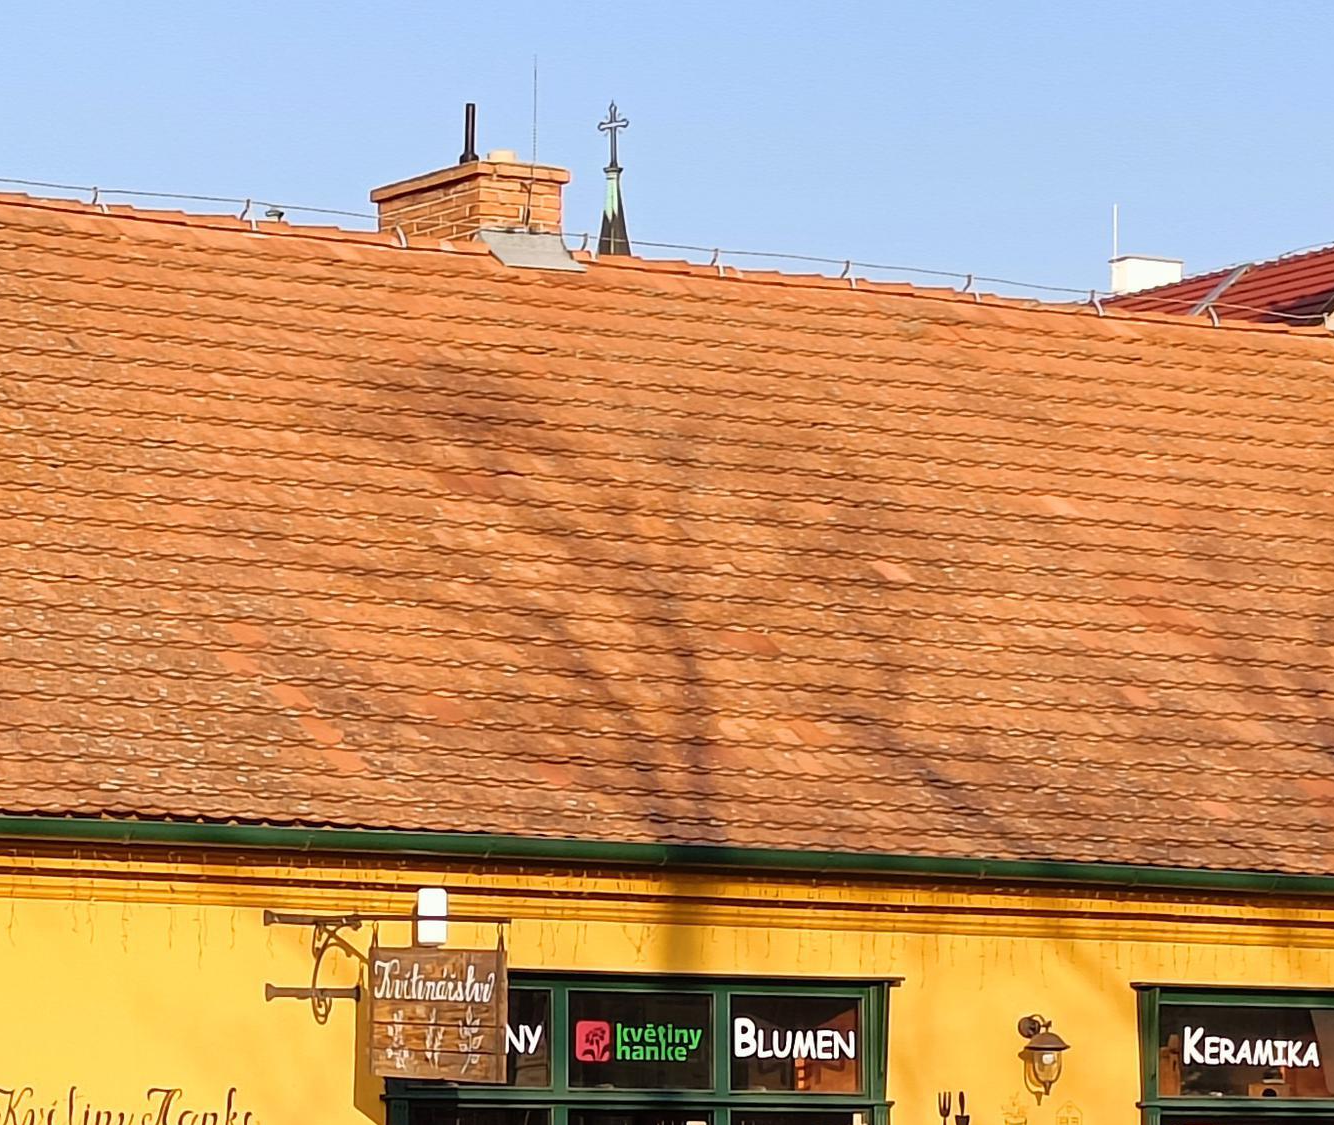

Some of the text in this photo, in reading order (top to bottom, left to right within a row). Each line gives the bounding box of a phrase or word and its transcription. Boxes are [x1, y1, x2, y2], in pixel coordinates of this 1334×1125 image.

[616, 1023, 703, 1050] květiny
[616, 1043, 688, 1062] hanke
[734, 1016, 856, 1060] BLUMEN
[1183, 1026, 1320, 1067] KERAMIKA
